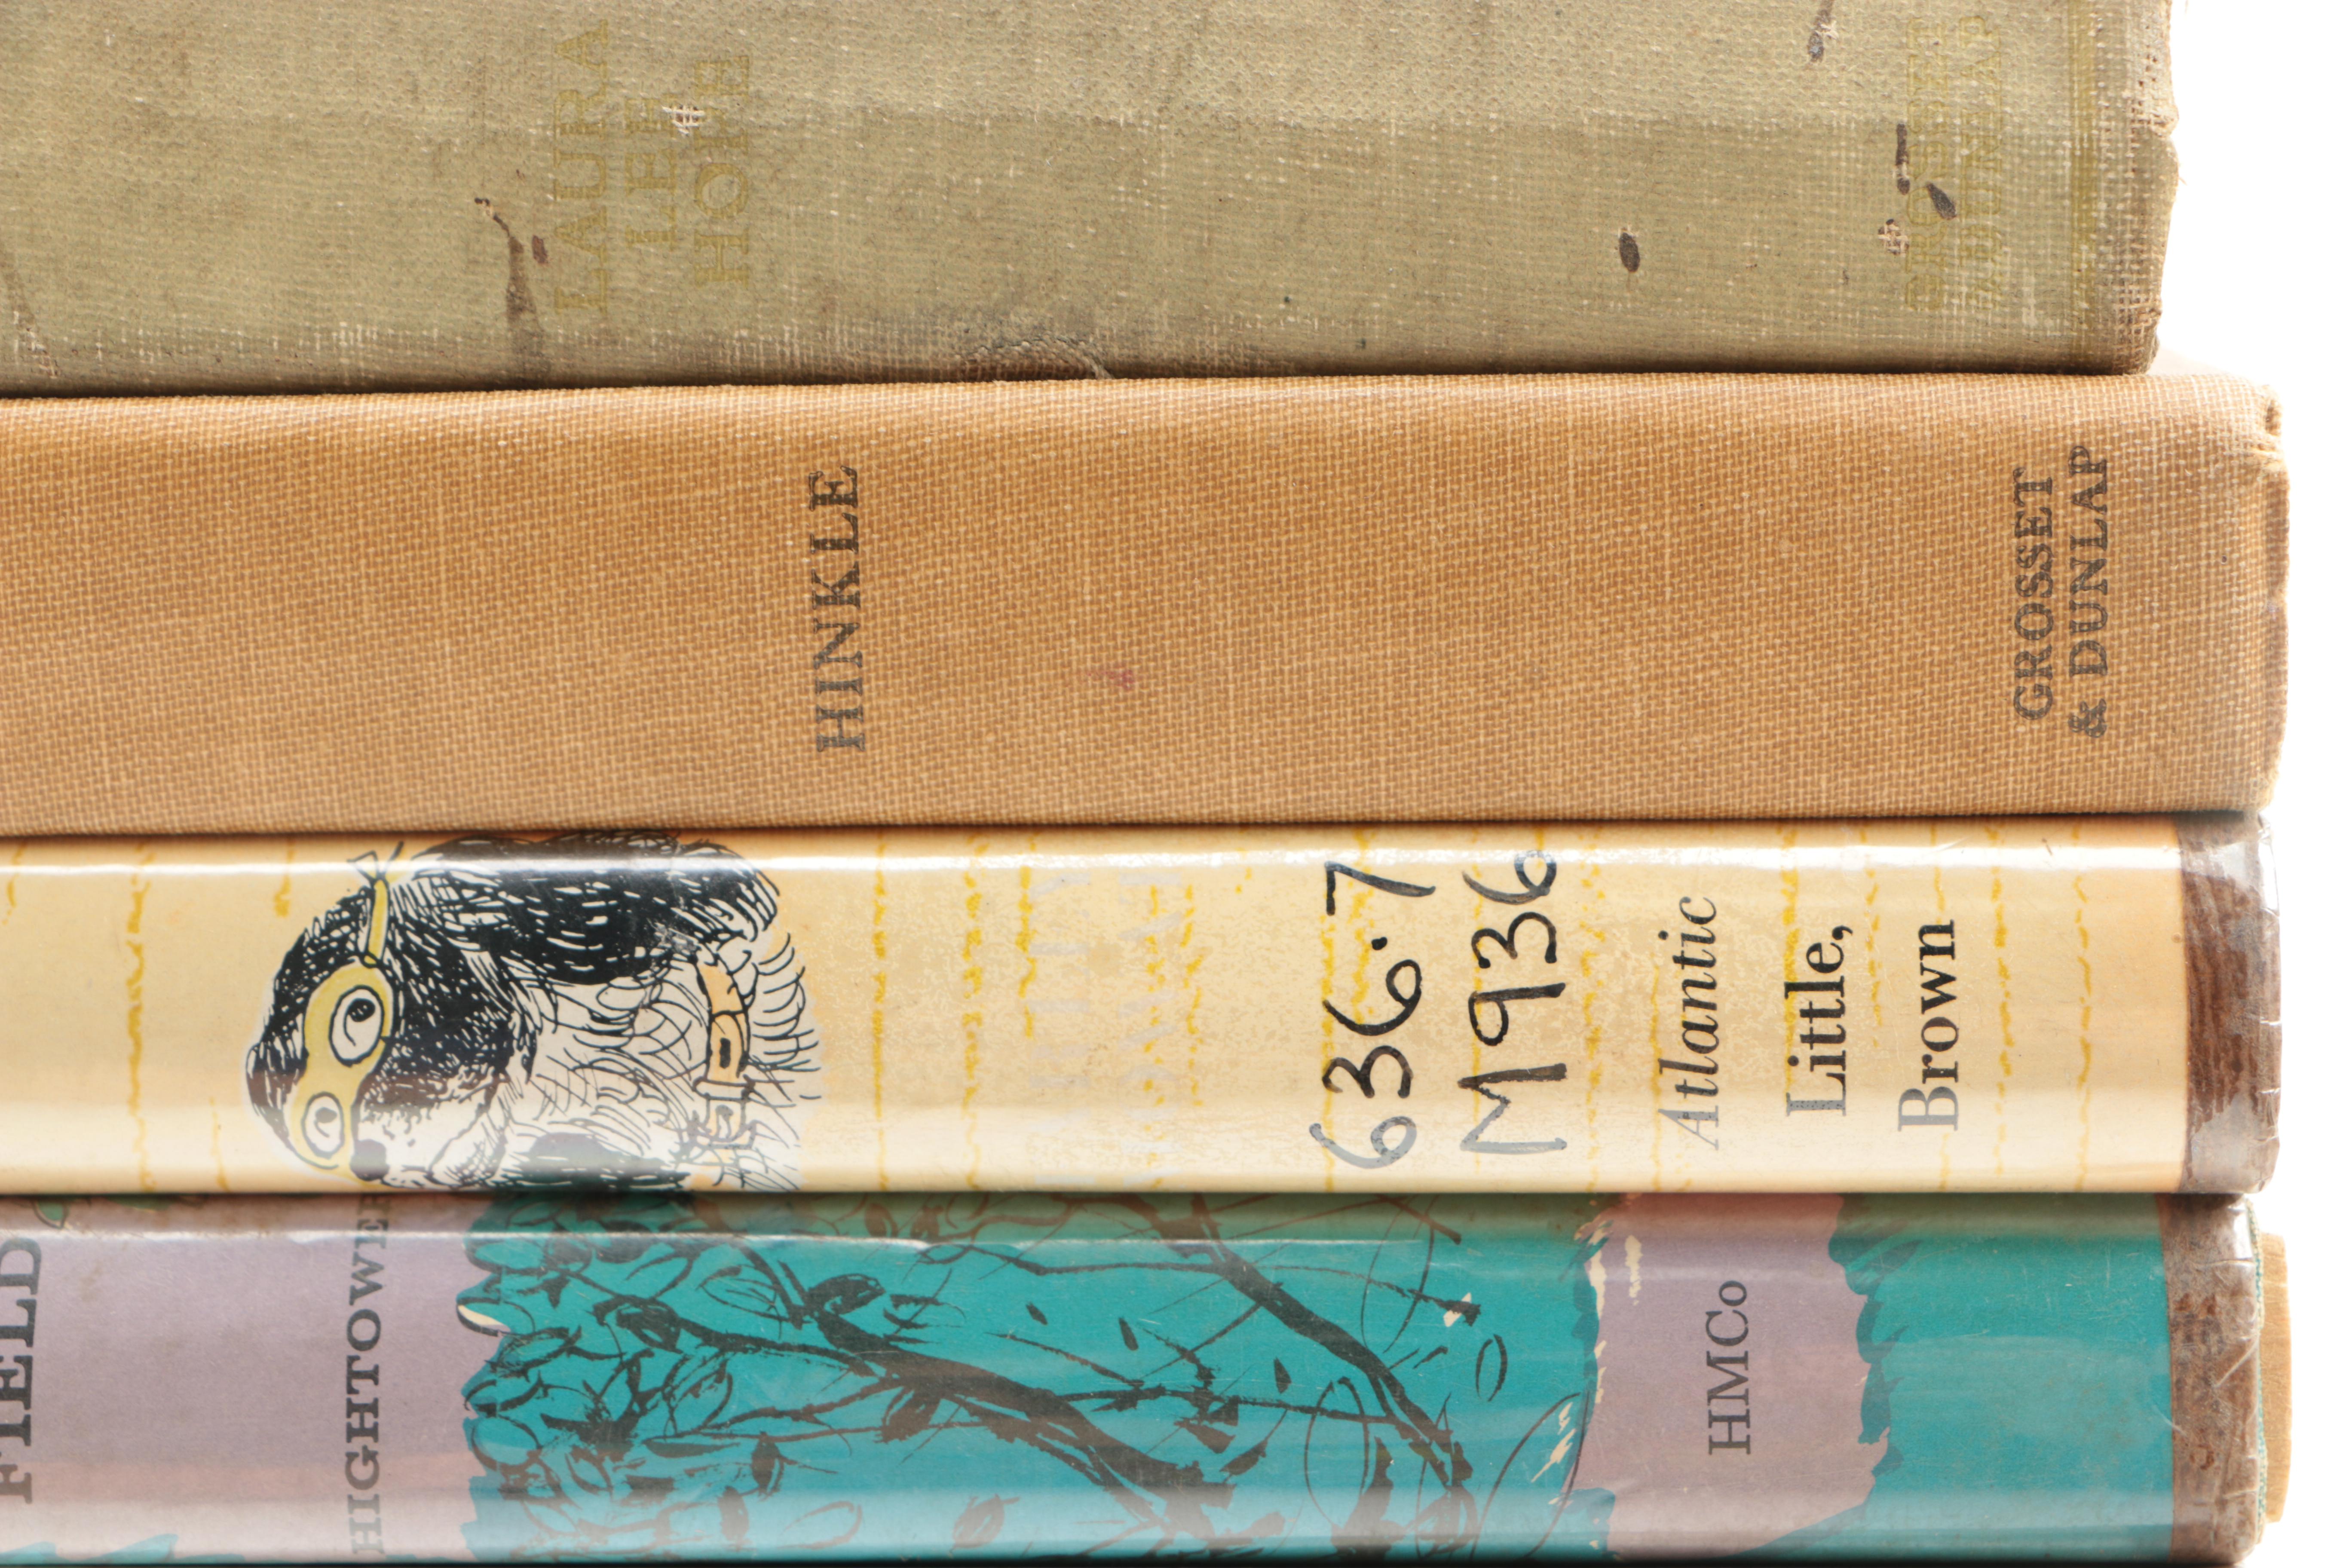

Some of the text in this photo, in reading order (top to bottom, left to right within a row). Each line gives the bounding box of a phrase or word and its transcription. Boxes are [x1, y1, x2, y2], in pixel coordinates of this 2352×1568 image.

[554, 19, 608, 315] LAURA
[624, 94, 678, 253] LEE
[694, 55, 750, 289] HOPE
[808, 465, 865, 752] HINKLE
[2012, 467, 2054, 720] GROSSET
[2068, 445, 2108, 738] & DUNLAP
[1309, 861, 1436, 1169] 636.7
[1457, 850, 1567, 1155] M936
[1657, 896, 1720, 1151] Atlantic
[1784, 925, 1853, 1117] Little,
[1898, 919, 1959, 1132] Brown
[0, 1237, 42, 1504] FIELD
[1705, 1280, 1751, 1455] HMCo
